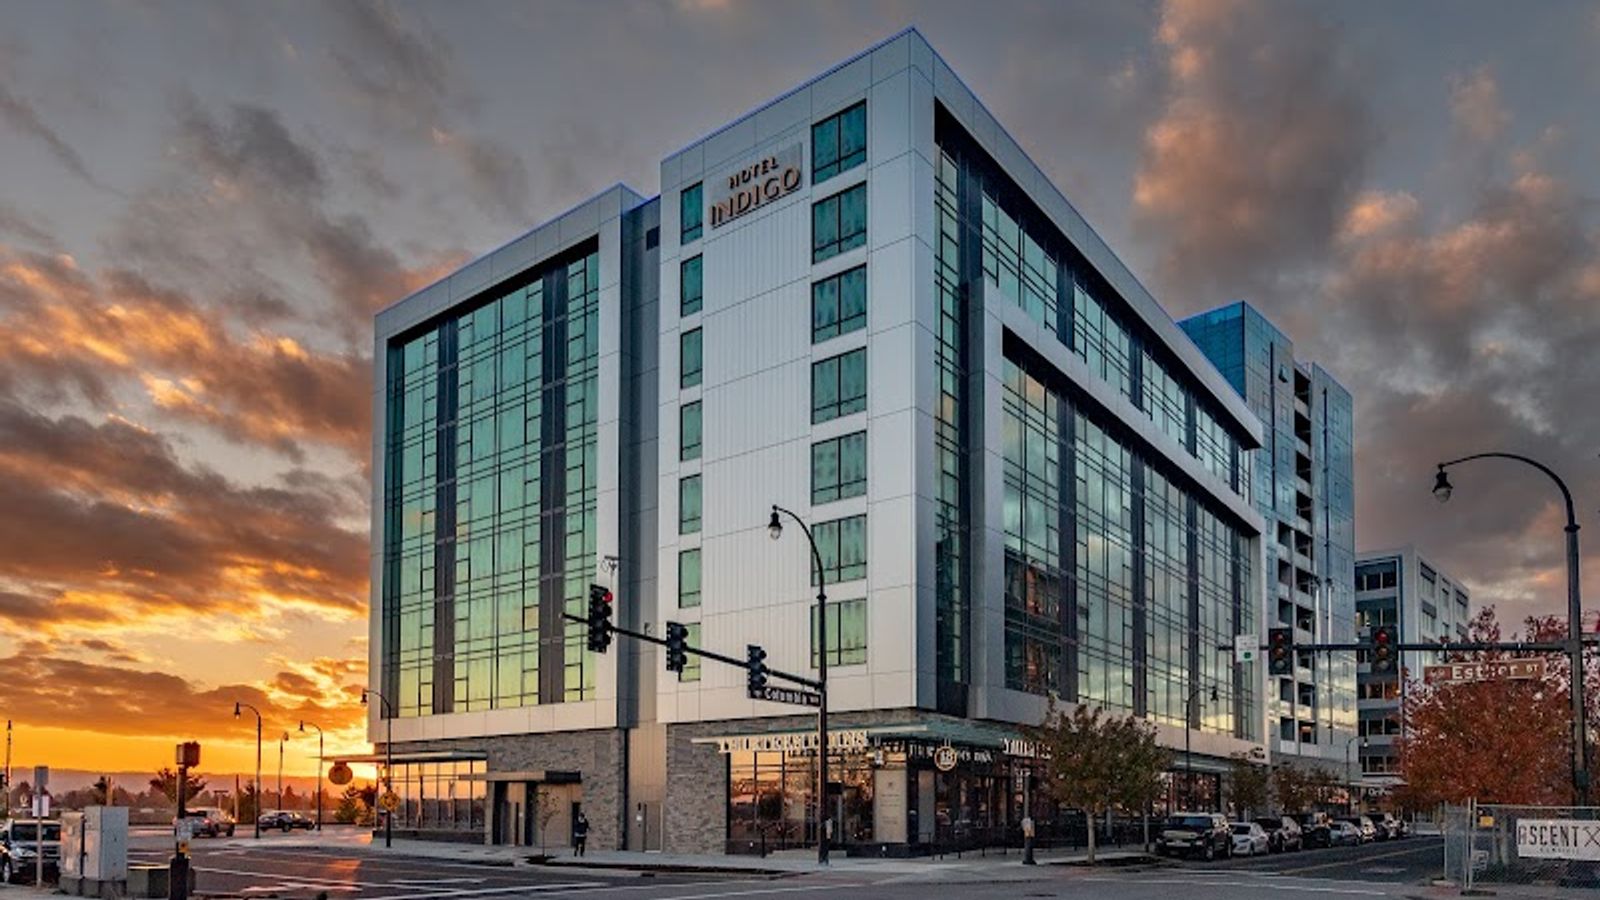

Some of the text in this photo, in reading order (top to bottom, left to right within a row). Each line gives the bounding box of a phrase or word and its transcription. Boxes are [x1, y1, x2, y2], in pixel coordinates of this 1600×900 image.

[728, 156, 779, 189] HOTEL
[709, 167, 801, 225] INDIGO
[1518, 825, 1579, 847] ASCENT
